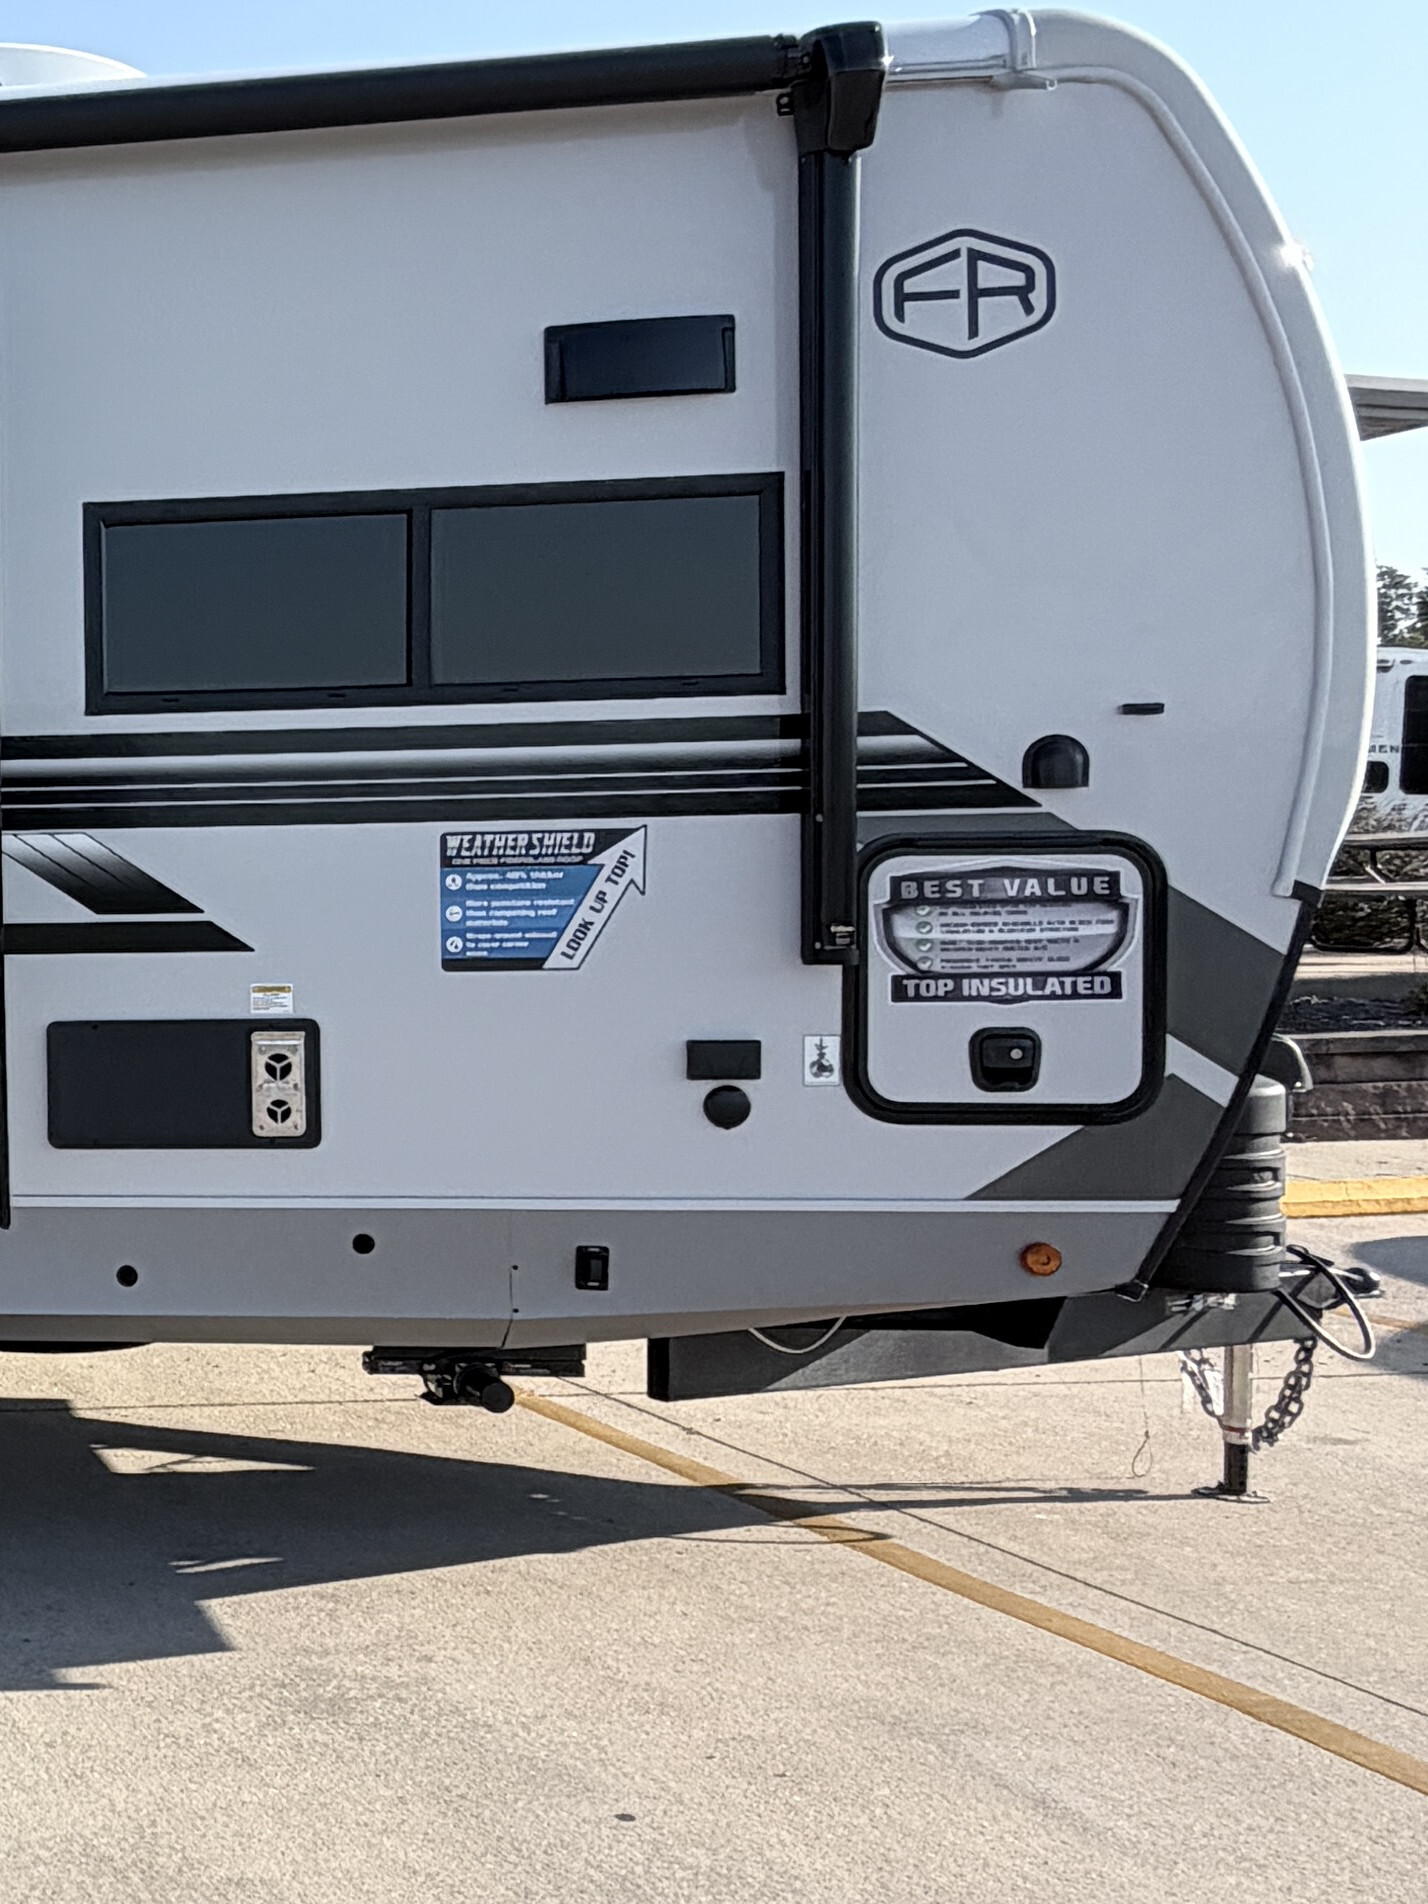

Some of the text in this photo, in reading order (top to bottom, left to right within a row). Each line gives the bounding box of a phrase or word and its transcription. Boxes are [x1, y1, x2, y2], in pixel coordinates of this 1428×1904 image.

[900, 876, 1111, 900] BEST VALUE
[560, 849, 637, 961] LOOK UP TOP!
[902, 975, 1112, 998] TOP INSULATED
